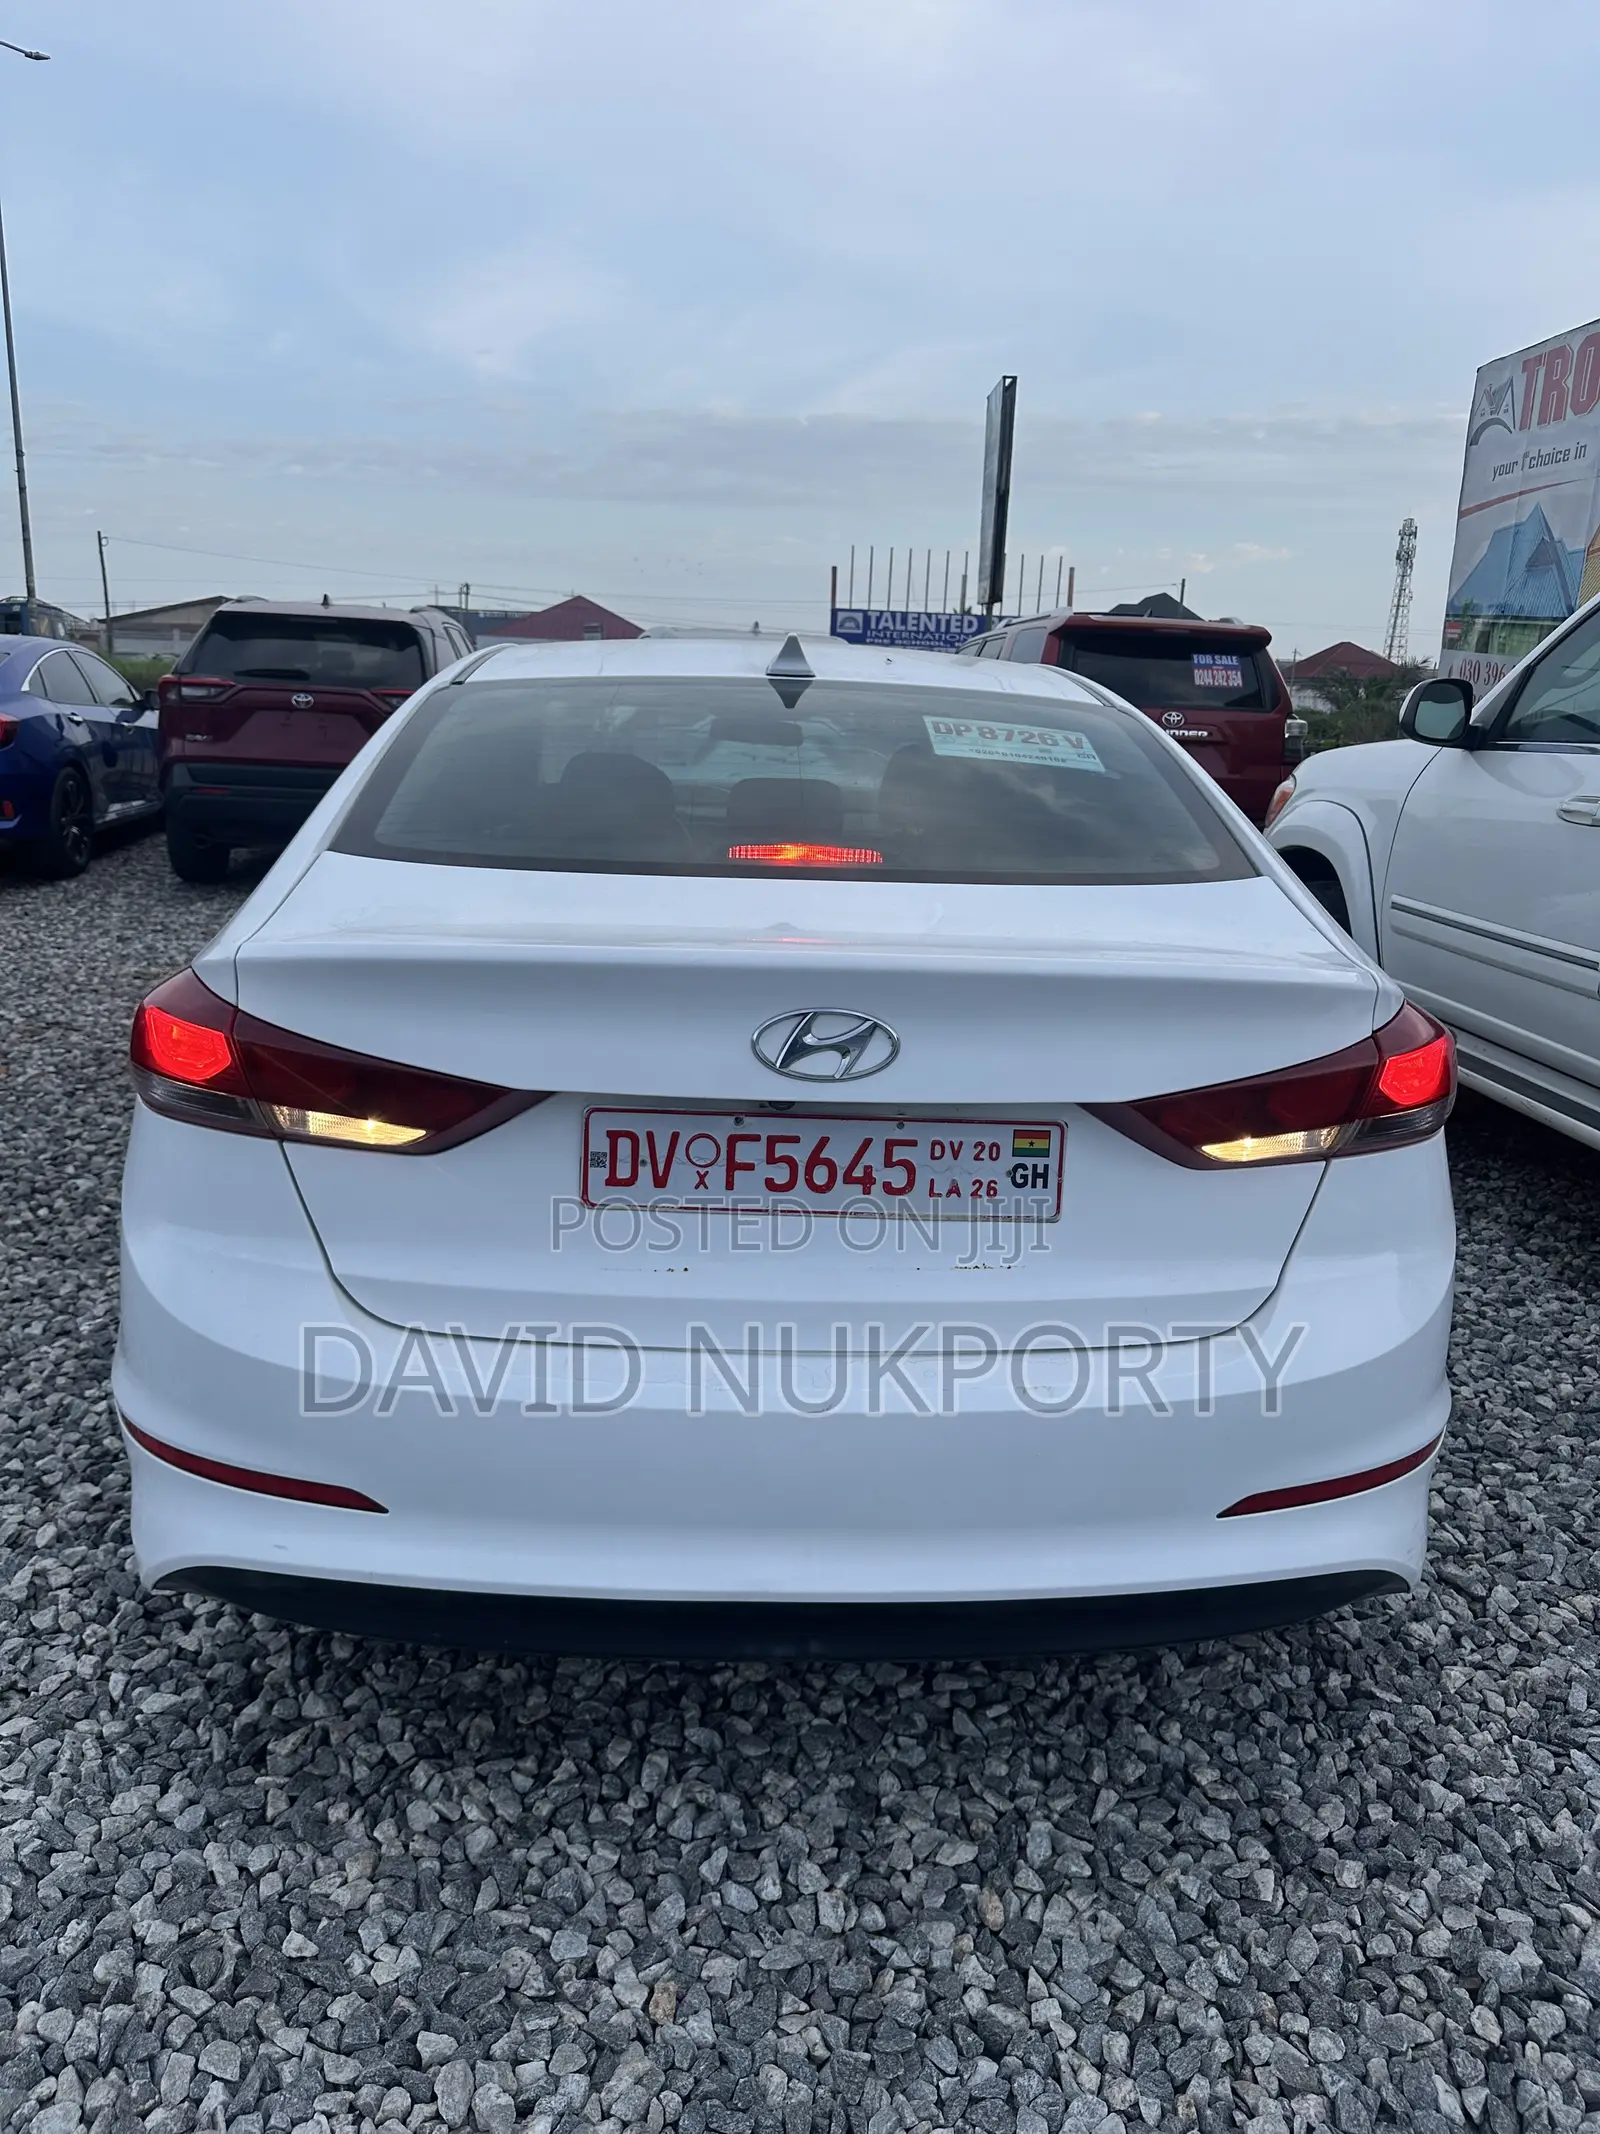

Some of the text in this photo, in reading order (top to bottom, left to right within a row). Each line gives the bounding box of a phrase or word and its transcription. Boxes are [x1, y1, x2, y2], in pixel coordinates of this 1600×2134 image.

[1492, 460, 1518, 482] your
[1528, 447, 1571, 470] choice
[1573, 441, 1587, 460] in
[867, 611, 979, 634] TALENTED
[1193, 654, 1239, 665] FOR SALE
[1460, 659, 1481, 684] 030
[1194, 669, 1213, 686] 0244
[1214, 670, 1227, 686] 242
[931, 721, 1084, 749] DP 8726 V
[605, 1129, 919, 1196] DV F5645
[929, 1139, 1001, 1162] DV 20
[1010, 1162, 1050, 1190] GH
[928, 1178, 999, 1199] LA 26
